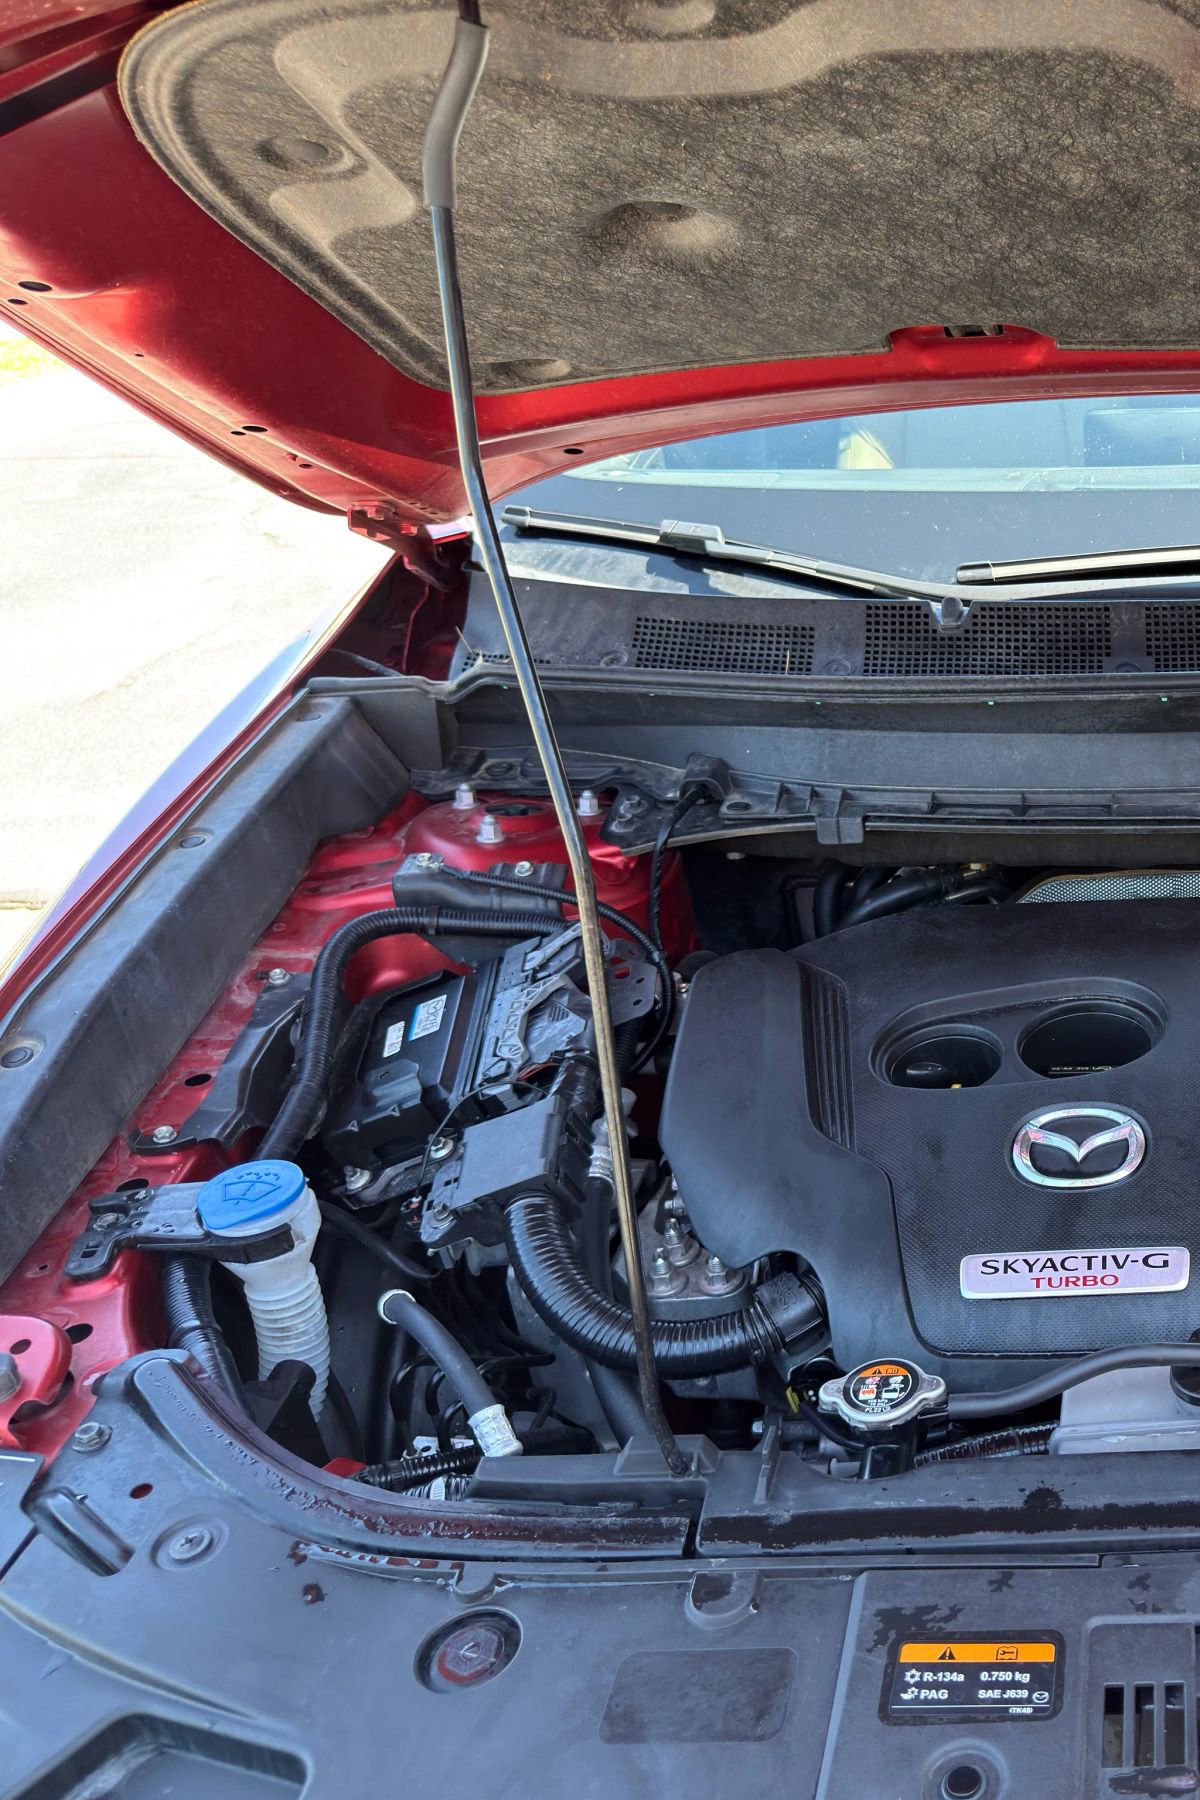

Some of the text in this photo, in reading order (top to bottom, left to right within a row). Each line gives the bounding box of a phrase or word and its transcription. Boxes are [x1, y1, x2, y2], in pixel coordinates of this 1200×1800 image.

[980, 1253, 1170, 1275] SKYACTIV-G
[1030, 1274, 1121, 1289] TURBO
[923, 1671, 1031, 1683] R-134a 0.750 kg
[919, 1689, 1029, 1700] PAG SAE J639
